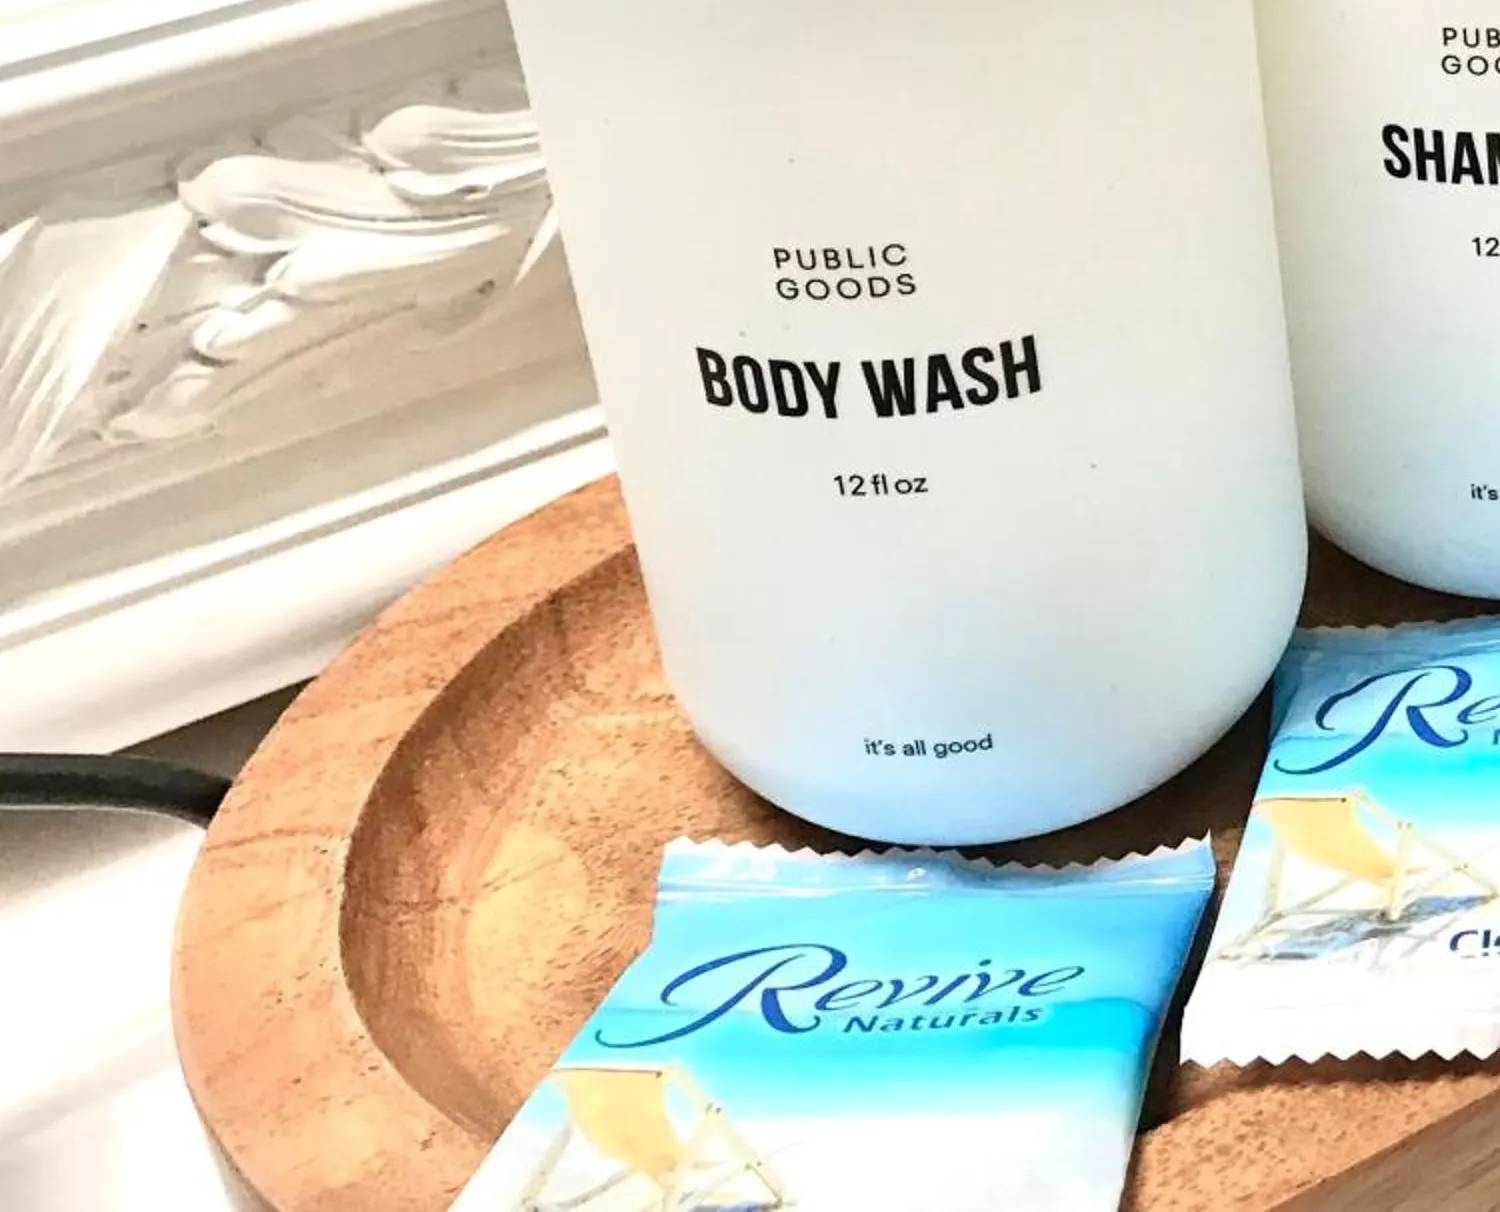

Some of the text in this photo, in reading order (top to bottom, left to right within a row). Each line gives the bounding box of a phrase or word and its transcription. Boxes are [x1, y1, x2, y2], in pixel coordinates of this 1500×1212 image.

[773, 243, 907, 271] PUBLIC
[1471, 237, 1500, 257] 12
[775, 273, 917, 301] GOODS
[695, 334, 1042, 420] BODY WASH
[833, 473, 929, 497] 12 fl oz
[1471, 483, 1499, 501] it's
[864, 733, 993, 759] it's all good
[595, 943, 1085, 1048] Revive
[842, 1002, 1044, 1035] Naturals
